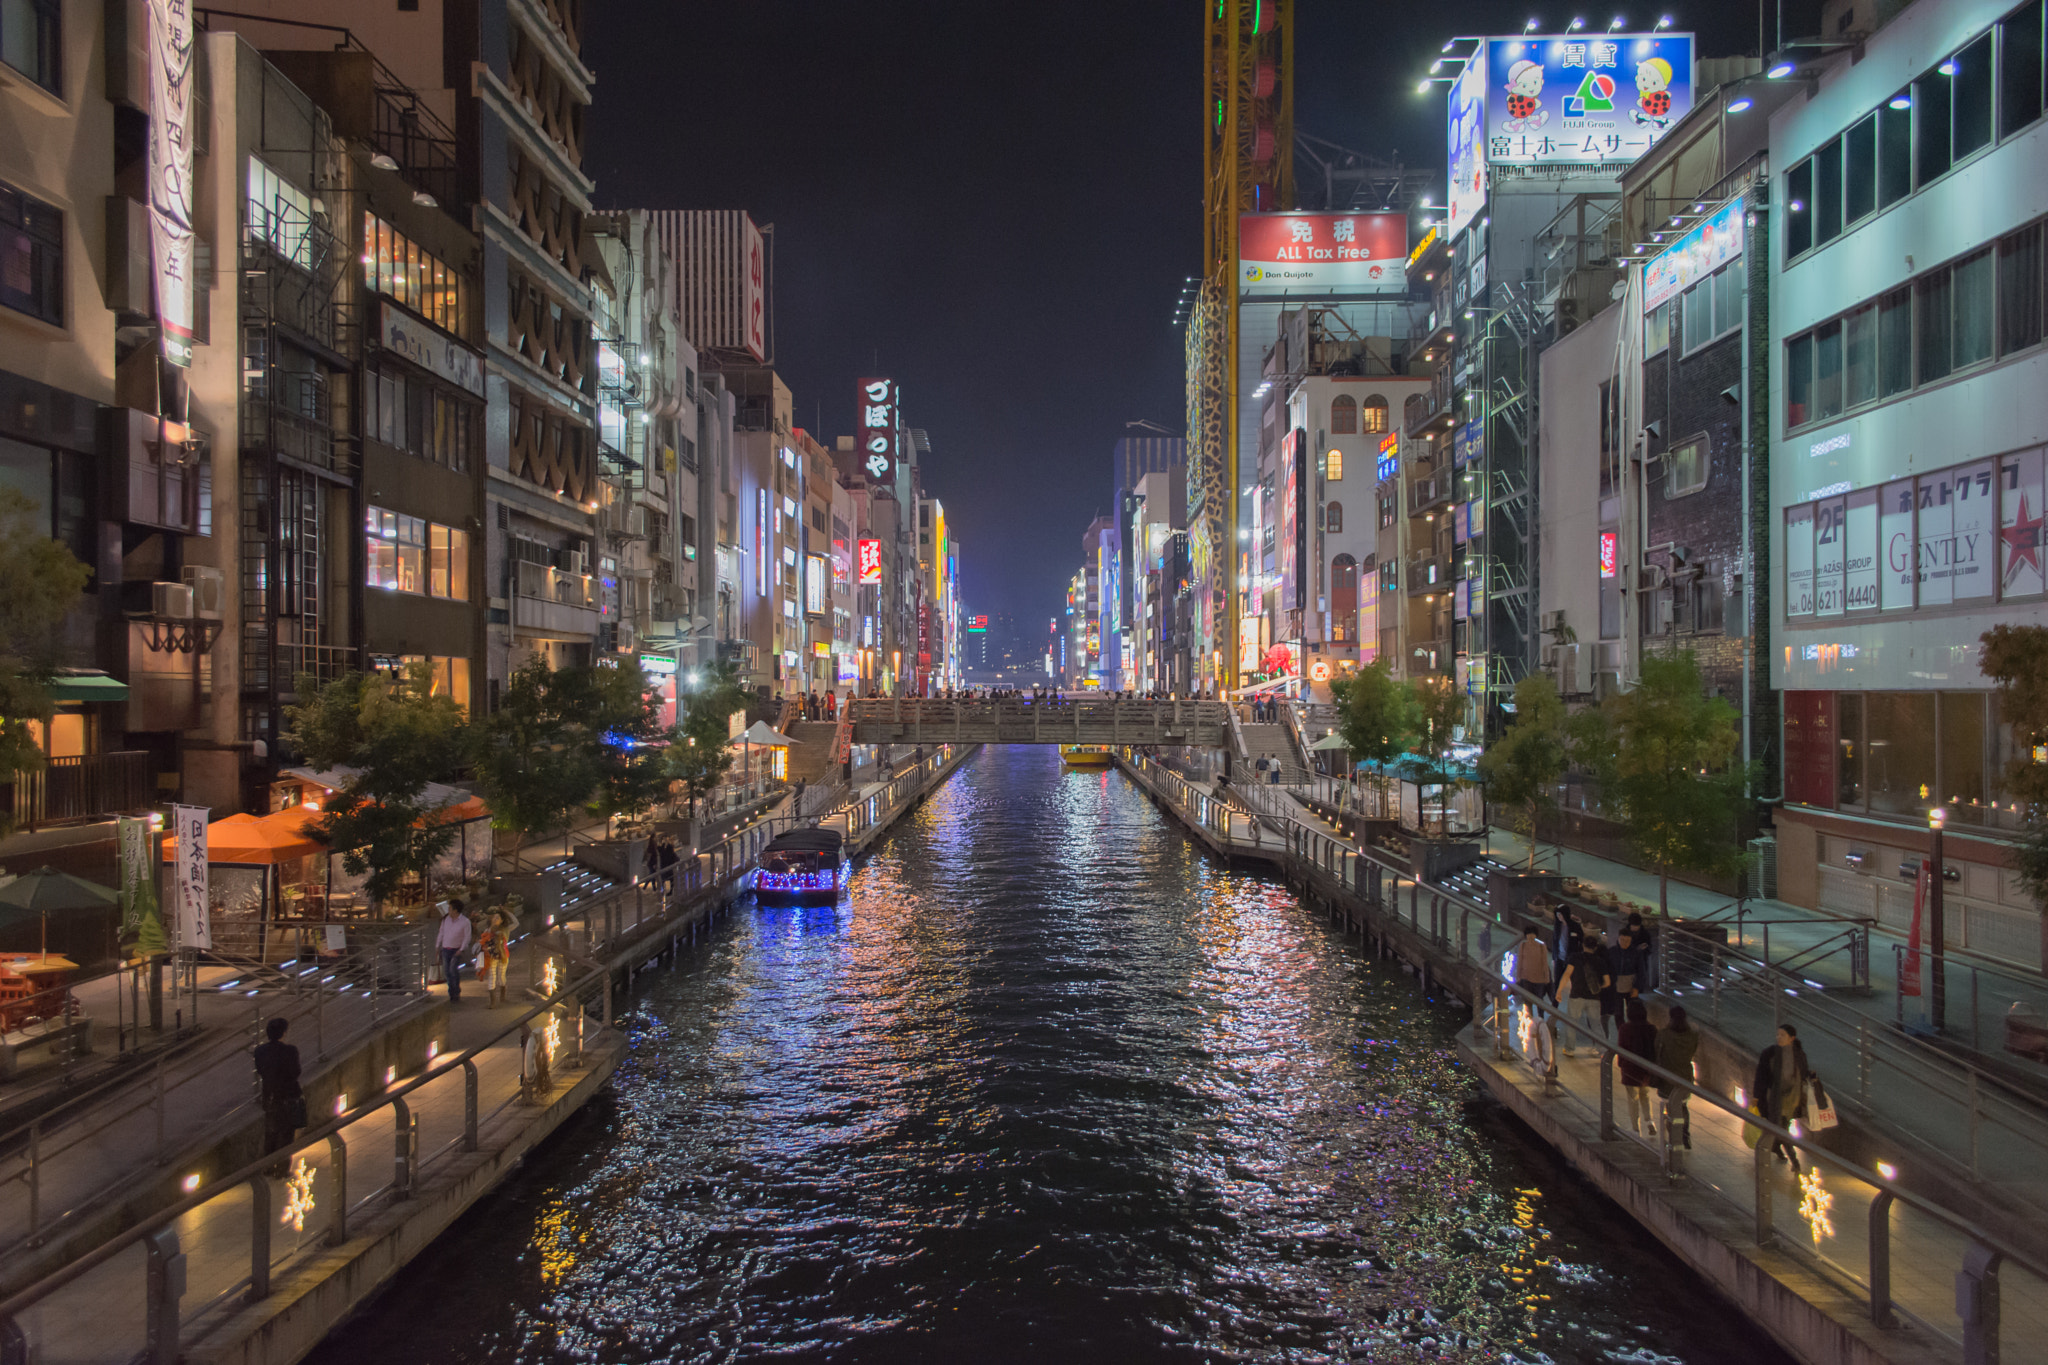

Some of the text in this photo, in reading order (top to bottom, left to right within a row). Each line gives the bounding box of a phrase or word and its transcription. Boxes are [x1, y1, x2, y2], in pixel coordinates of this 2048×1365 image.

[1562, 43, 1617, 69] 賃貸
[1562, 120, 1615, 130] FUJI Group
[1291, 220, 1356, 244] 免税
[1276, 245, 1371, 260] ALL Tax Free
[1265, 270, 1314, 280] Don Quijote
[751, 234, 762, 349] かに
[865, 379, 892, 478] づぼらや
[1899, 457, 2021, 514] ホストクラブ
[1818, 504, 1843, 546] 2F
[1847, 556, 1872, 571] GROUP
[1800, 593, 1813, 613] 06
[1818, 588, 1844, 611] 6211
[1847, 584, 1876, 606] 4440
